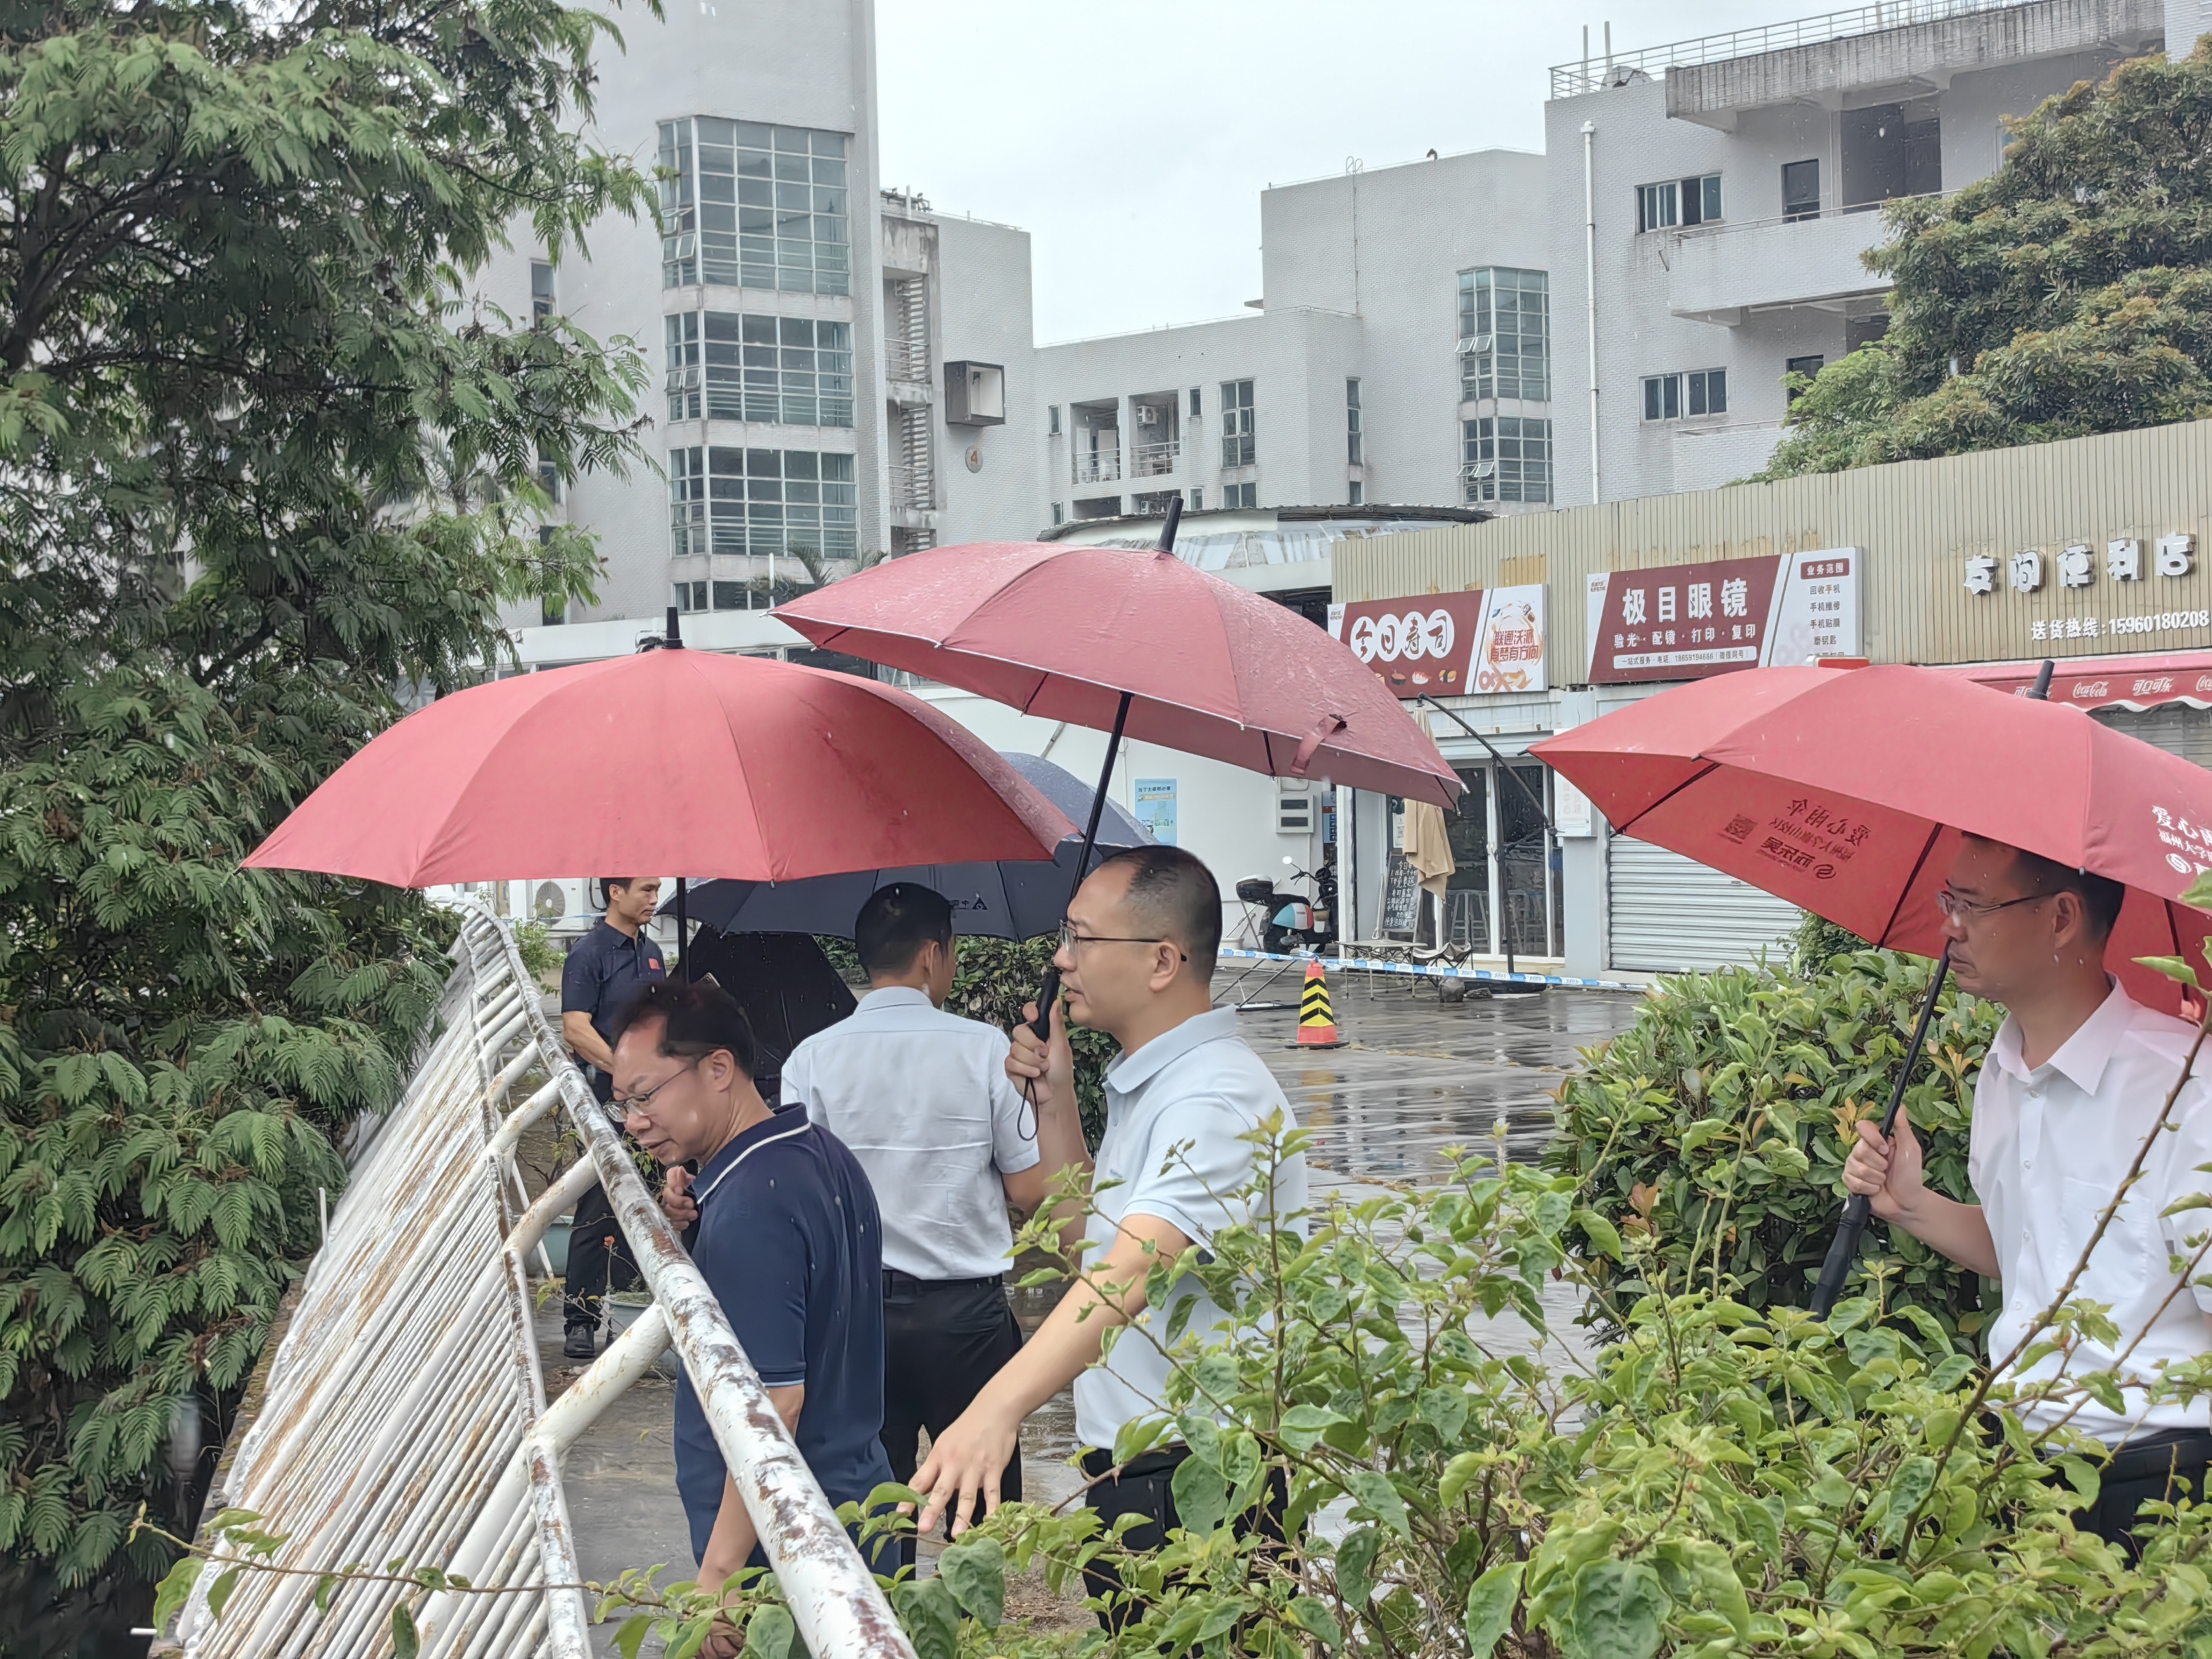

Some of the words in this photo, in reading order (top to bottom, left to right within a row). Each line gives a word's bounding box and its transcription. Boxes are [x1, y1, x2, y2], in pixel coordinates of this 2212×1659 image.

[1806, 562, 1844, 576] 业务范围
[1810, 584, 1840, 595] 回收手机
[1622, 577, 1748, 625] 极目眼镜
[1810, 601, 1840, 612] 手机维修
[1810, 618, 1840, 629] 手机贴膜
[1355, 616, 1447, 658] 今日寿司
